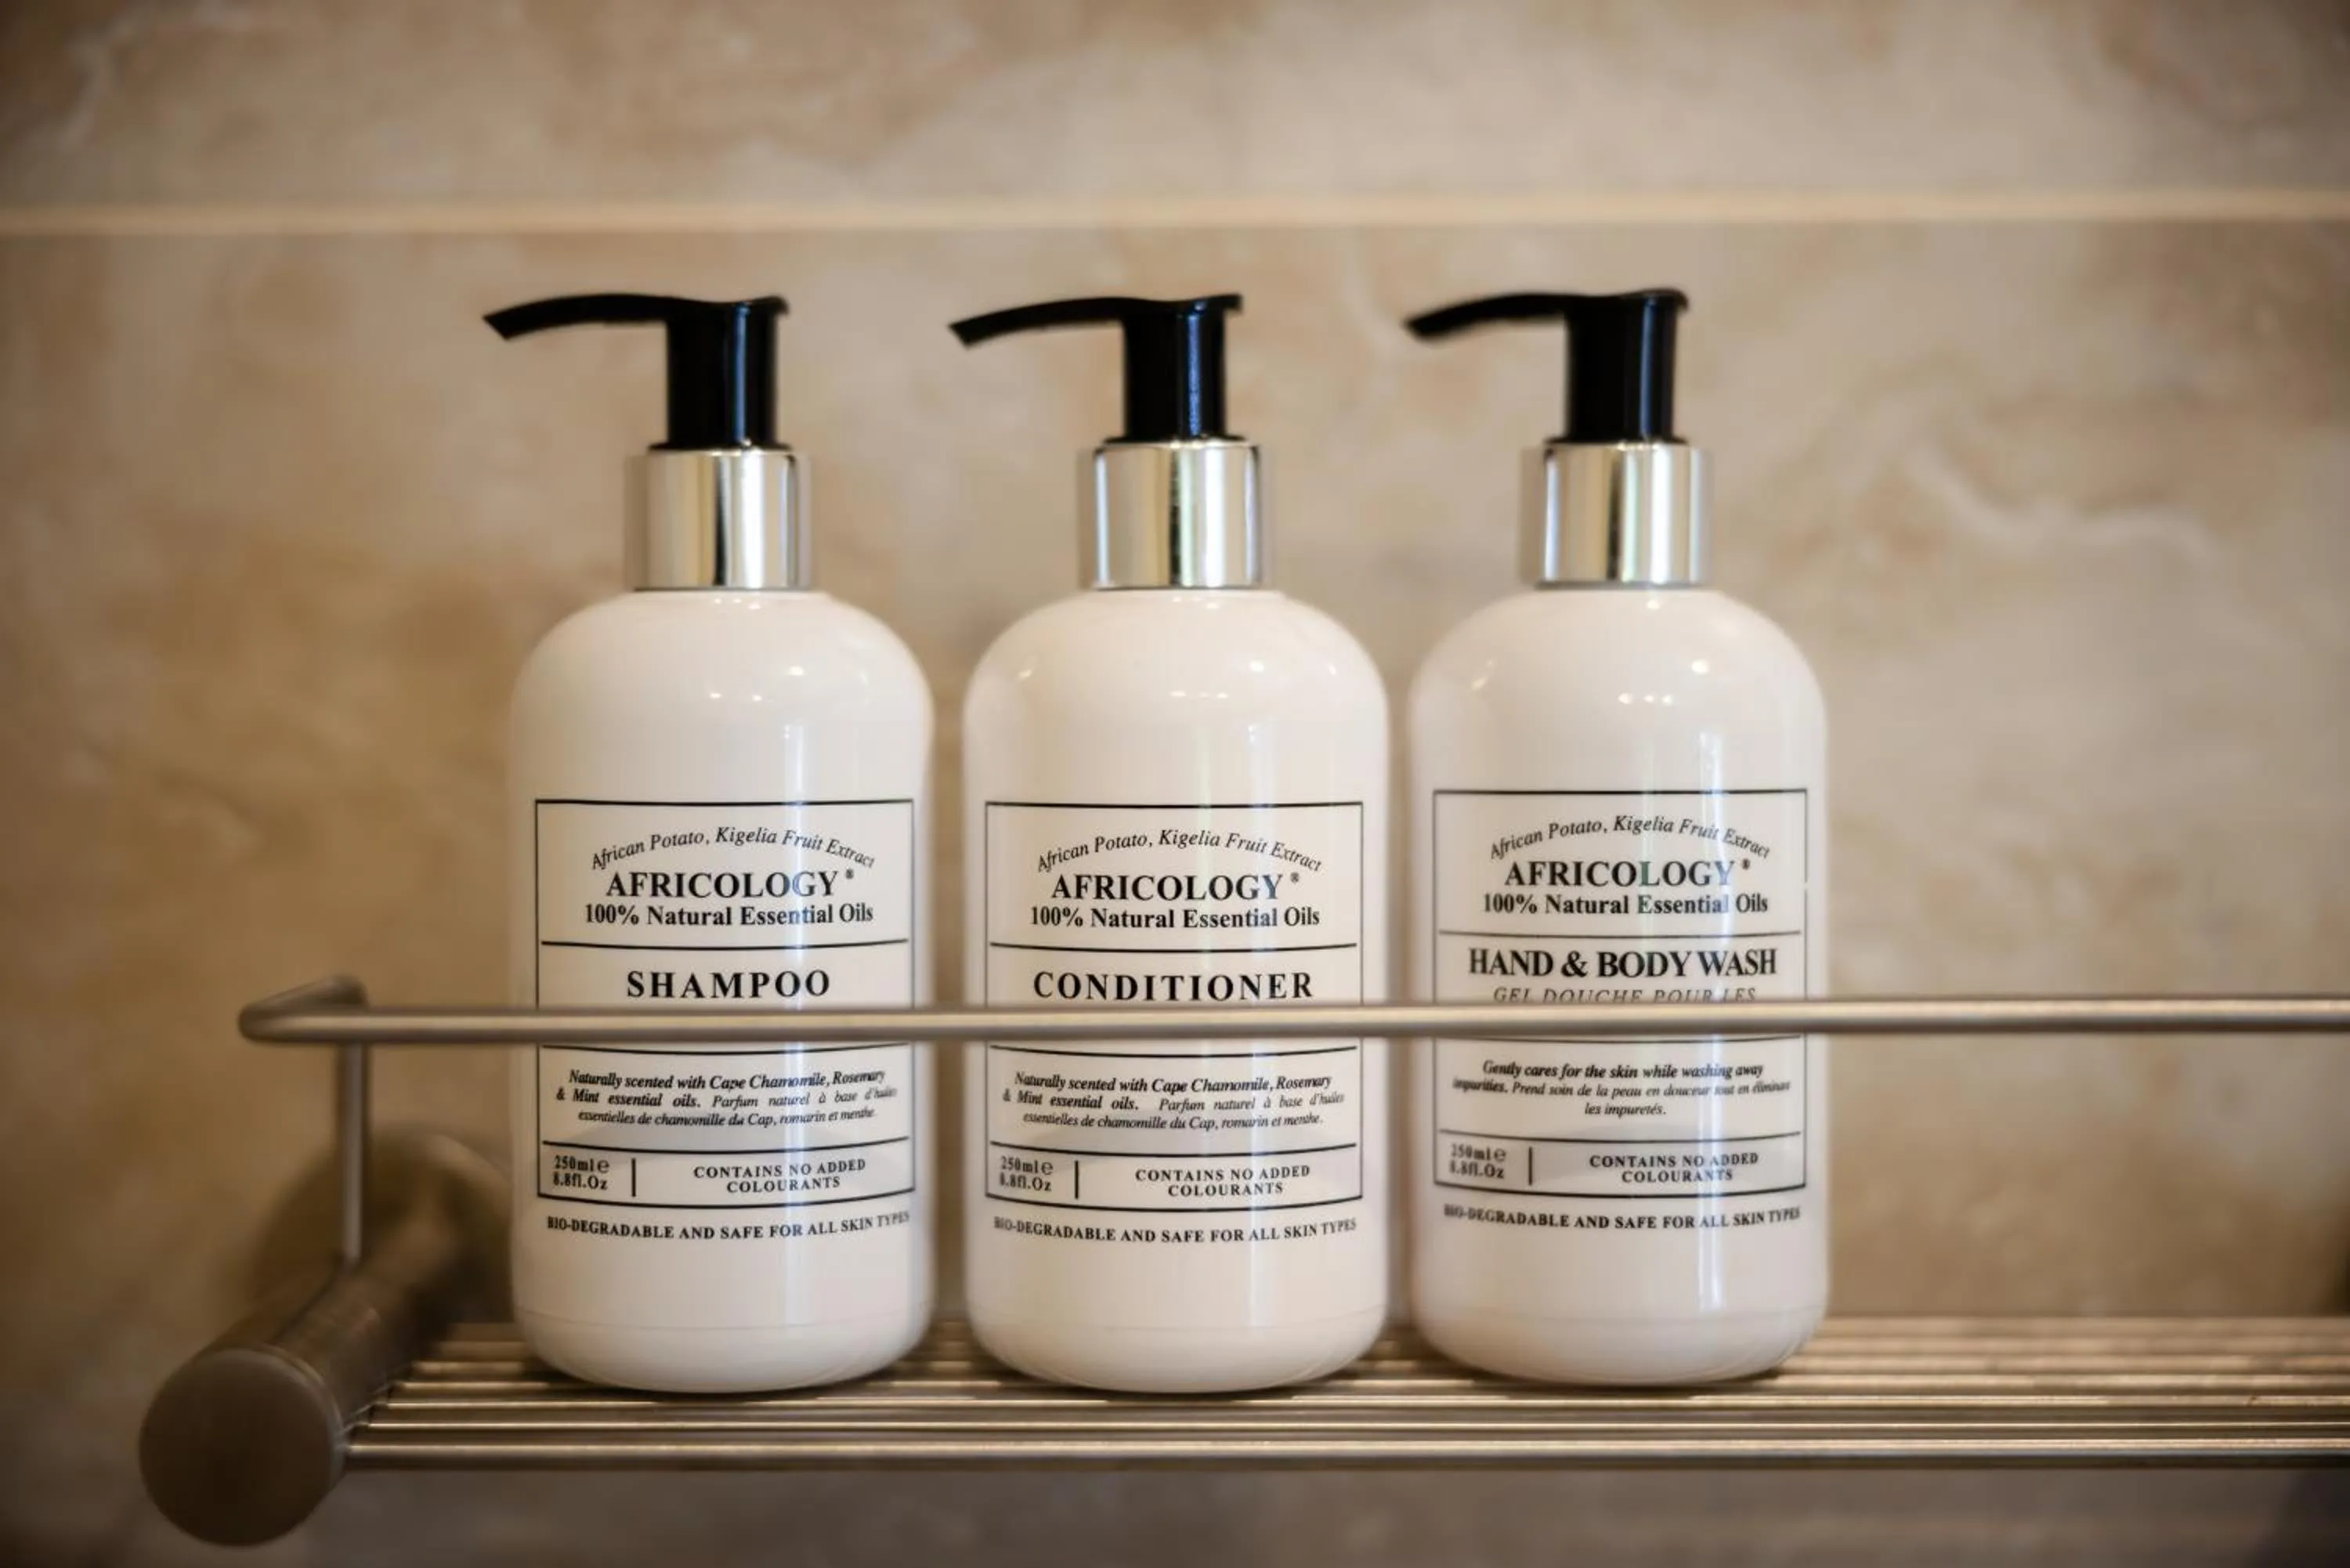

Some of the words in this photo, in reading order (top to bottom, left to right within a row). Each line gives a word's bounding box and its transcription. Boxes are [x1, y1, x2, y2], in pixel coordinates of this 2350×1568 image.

[1490, 829, 1543, 859] African
[1548, 819, 1608, 839] Potato,
[1613, 815, 1674, 834] Kigelia
[1679, 819, 1720, 840] Fruit
[1723, 829, 1770, 858] Extract
[591, 840, 645, 871] African
[649, 831, 710, 851] Potato,
[715, 827, 778, 845] Kigelia
[781, 829, 824, 851] Fruit
[825, 842, 876, 869] Extract
[1037, 842, 1090, 873] African
[1094, 833, 1153, 854] Potato,
[1158, 829, 1221, 847] Kigelia
[1226, 833, 1268, 854] Fruit
[1271, 843, 1323, 871] Extract
[606, 872, 839, 898] AFRICOLOGY
[1504, 861, 1735, 887] AFRICOLOGY
[1051, 874, 1284, 901] AFRICOLOGY
[585, 904, 639, 925] 100%
[647, 905, 732, 925] Natural
[740, 905, 833, 925] Essential
[839, 902, 873, 923] Oils
[1484, 894, 1538, 914] 100%
[1545, 894, 1629, 914] Natural
[1637, 894, 1729, 914] Essential
[1735, 893, 1768, 913] Oils
[1031, 905, 1083, 927] 100%
[1090, 908, 1175, 929] Natural
[1183, 909, 1278, 929] Essential
[1284, 905, 1320, 926] Oils
[1469, 947, 1553, 977] HAND
[1561, 951, 1587, 977] &
[1597, 950, 1692, 978] BODY
[1699, 948, 1777, 977] WASH
[627, 970, 830, 999] SHAMPOO
[1032, 971, 1313, 1002] CONDITIONER
[1493, 987, 1531, 1003] GEL
[1542, 988, 1643, 1003] DOUCHE
[568, 1070, 622, 1089] Naturally
[624, 1075, 674, 1089] scented
[677, 1075, 707, 1089] with
[710, 1075, 747, 1092] Cape
[749, 1072, 830, 1090] Chamomile,
[832, 1070, 886, 1085] Rosemary
[1482, 1060, 1522, 1078] Gently
[1525, 1064, 1558, 1078] cares
[1559, 1064, 1582, 1079] for
[1585, 1065, 1607, 1078] the
[1610, 1064, 1639, 1078] skin
[1643, 1063, 1678, 1078] while
[1682, 1062, 1733, 1079] washing
[1735, 1063, 1764, 1078] away
[1013, 1071, 1067, 1091] Naturally
[1068, 1076, 1115, 1092] scented
[1119, 1078, 1148, 1093] with
[1152, 1078, 1188, 1095] Cape
[1191, 1077, 1274, 1093] Chamomile,
[1275, 1075, 1332, 1090] Rosemary
[1512, 1082, 1546, 1095] Prend
[1549, 1083, 1574, 1096] soin
[1577, 1082, 1593, 1096] de
[1596, 1083, 1609, 1097] la
[1611, 1086, 1642, 1099] peau
[1646, 1086, 1661, 1097] en
[1664, 1082, 1710, 1097] douceur
[1737, 1082, 1751, 1094] en
[556, 1088, 565, 1100] &
[573, 1088, 599, 1104] Mint
[608, 1092, 663, 1107] essential
[673, 1093, 701, 1107] oils.
[712, 1094, 759, 1111] Parfum
[768, 1092, 810, 1107] naturel
[819, 1090, 826, 1104] à
[834, 1089, 857, 1103] base
[1018, 1090, 1043, 1107] Mint
[1050, 1095, 1103, 1111] essential
[1111, 1097, 1140, 1111] oils.
[1159, 1097, 1206, 1113] Parfum
[1213, 1095, 1256, 1111] naturel
[1264, 1093, 1272, 1109] à
[1278, 1093, 1303, 1107] base
[1585, 1103, 1602, 1116] les
[1604, 1104, 1667, 1119] impuretés.
[578, 1109, 635, 1125] essentielles
[638, 1112, 653, 1125] de
[654, 1112, 725, 1127] chamomille
[727, 1113, 744, 1127] du
[747, 1112, 778, 1129] Cap,
[779, 1111, 826, 1124] romarin
[828, 1110, 838, 1122] et
[1023, 1111, 1079, 1127] essentielles
[1081, 1115, 1095, 1128] de
[1097, 1115, 1167, 1129] chamomille
[1170, 1117, 1187, 1130] du
[1188, 1115, 1219, 1132] Cap,
[1221, 1114, 1270, 1129] romarin
[1272, 1113, 1282, 1127] et
[693, 1165, 783, 1179] CONTAINS
[789, 1163, 812, 1176] NO
[816, 1158, 866, 1174] ADDED
[1589, 1154, 1676, 1168] CONTAINS
[1683, 1154, 1705, 1167] NO
[1708, 1152, 1759, 1165] ADDED
[552, 1175, 609, 1191] 8.8fl.Oz
[726, 1176, 841, 1194] COLOURANTS
[1135, 1169, 1224, 1182] CONTAINS
[1230, 1168, 1255, 1180] NO
[1259, 1165, 1310, 1179] ADDED
[1622, 1169, 1734, 1183] COLOURANTS
[1168, 1183, 1284, 1197] COLOURANTS
[547, 1215, 674, 1239] BIO-DEGRADABLE
[679, 1226, 715, 1240] AND
[719, 1226, 765, 1240] SAFE
[769, 1223, 803, 1238] FOR
[807, 1220, 838, 1236] ALL
[840, 1216, 873, 1234] SKIN
[877, 1211, 910, 1229] TYPES
[1444, 1203, 1569, 1227] BIO-DEGRADABLE
[1574, 1215, 1610, 1229] AND
[1614, 1216, 1658, 1229] SAFE
[1662, 1215, 1696, 1229] FOR
[1700, 1213, 1729, 1228] ALL
[1732, 1210, 1765, 1227] SKIN
[1768, 1207, 1801, 1222] TYPES
[993, 1216, 1116, 1241] BIO-DEGRADABLE
[1120, 1227, 1156, 1242] AND
[1162, 1229, 1206, 1243] SAFE
[1210, 1229, 1245, 1243] FOR
[1249, 1226, 1282, 1241] ALL
[1283, 1222, 1318, 1238] SKIN
[1320, 1218, 1358, 1234] TYPES
